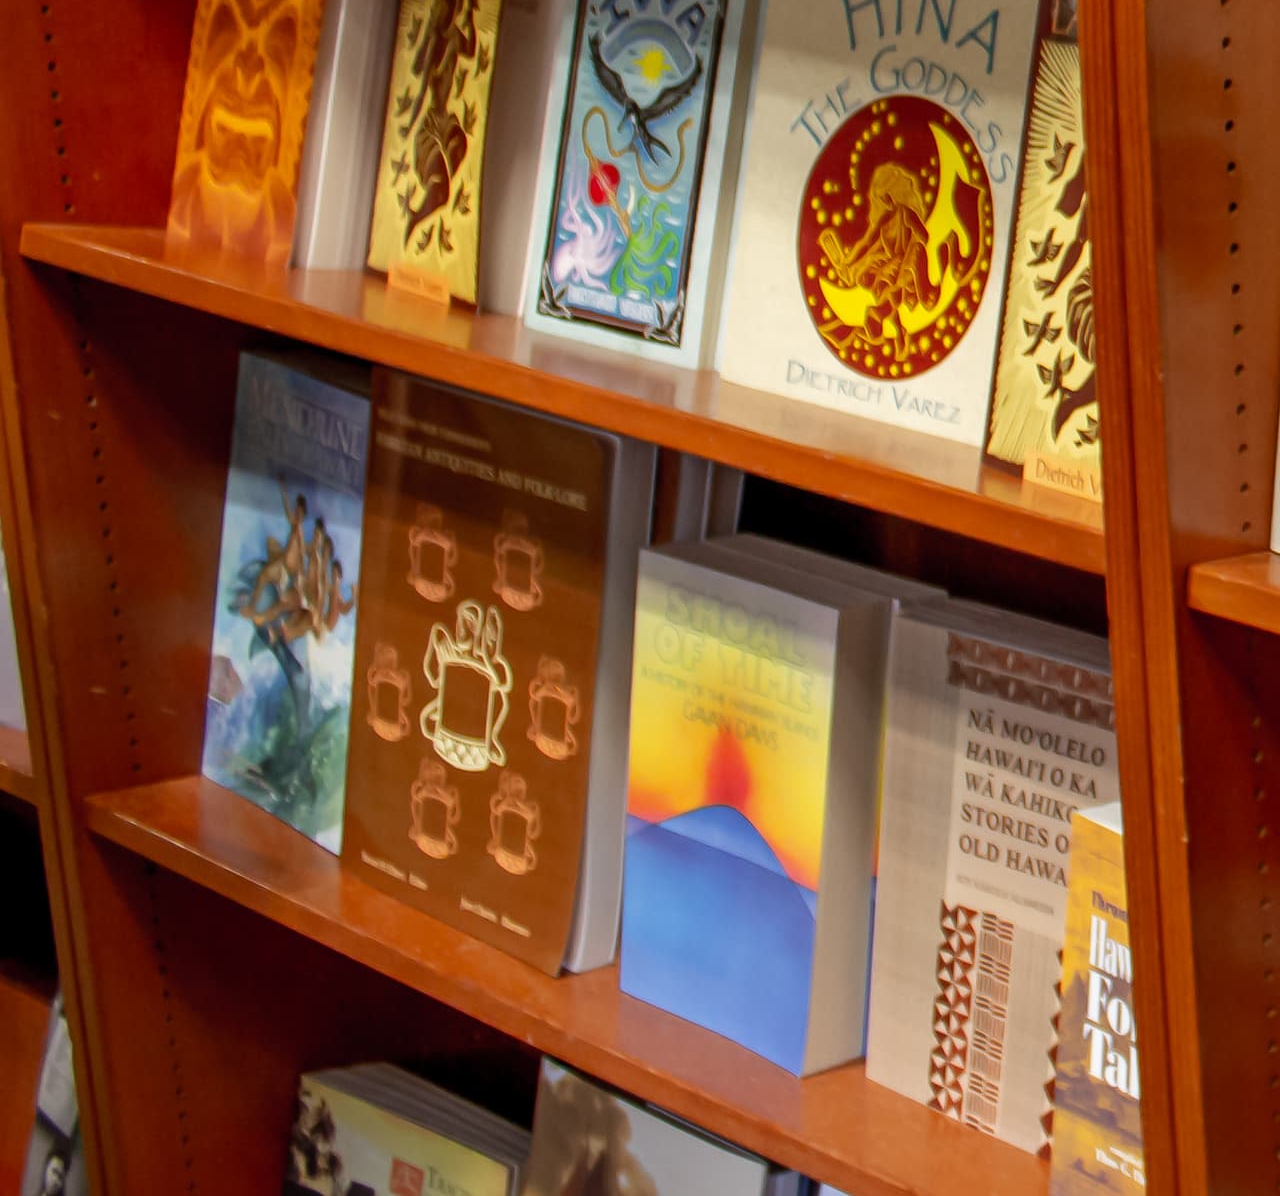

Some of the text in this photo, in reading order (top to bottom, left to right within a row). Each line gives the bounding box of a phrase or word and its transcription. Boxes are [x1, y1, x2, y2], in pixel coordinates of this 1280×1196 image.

[790, 44, 1014, 184] THE GODDESS
[1035, 459, 1084, 490] Dietrich
[654, 625, 704, 674] OF
[970, 708, 996, 734] NĀ
[965, 772, 995, 800] WĀ
[1050, 768, 1065, 788] O
[1069, 772, 1097, 800] KA
[960, 804, 1071, 855] STORIES O
[958, 834, 1070, 889] OLD HAWA
[1088, 915, 1133, 984] Haw
[1082, 1022, 1142, 1100] Tal
